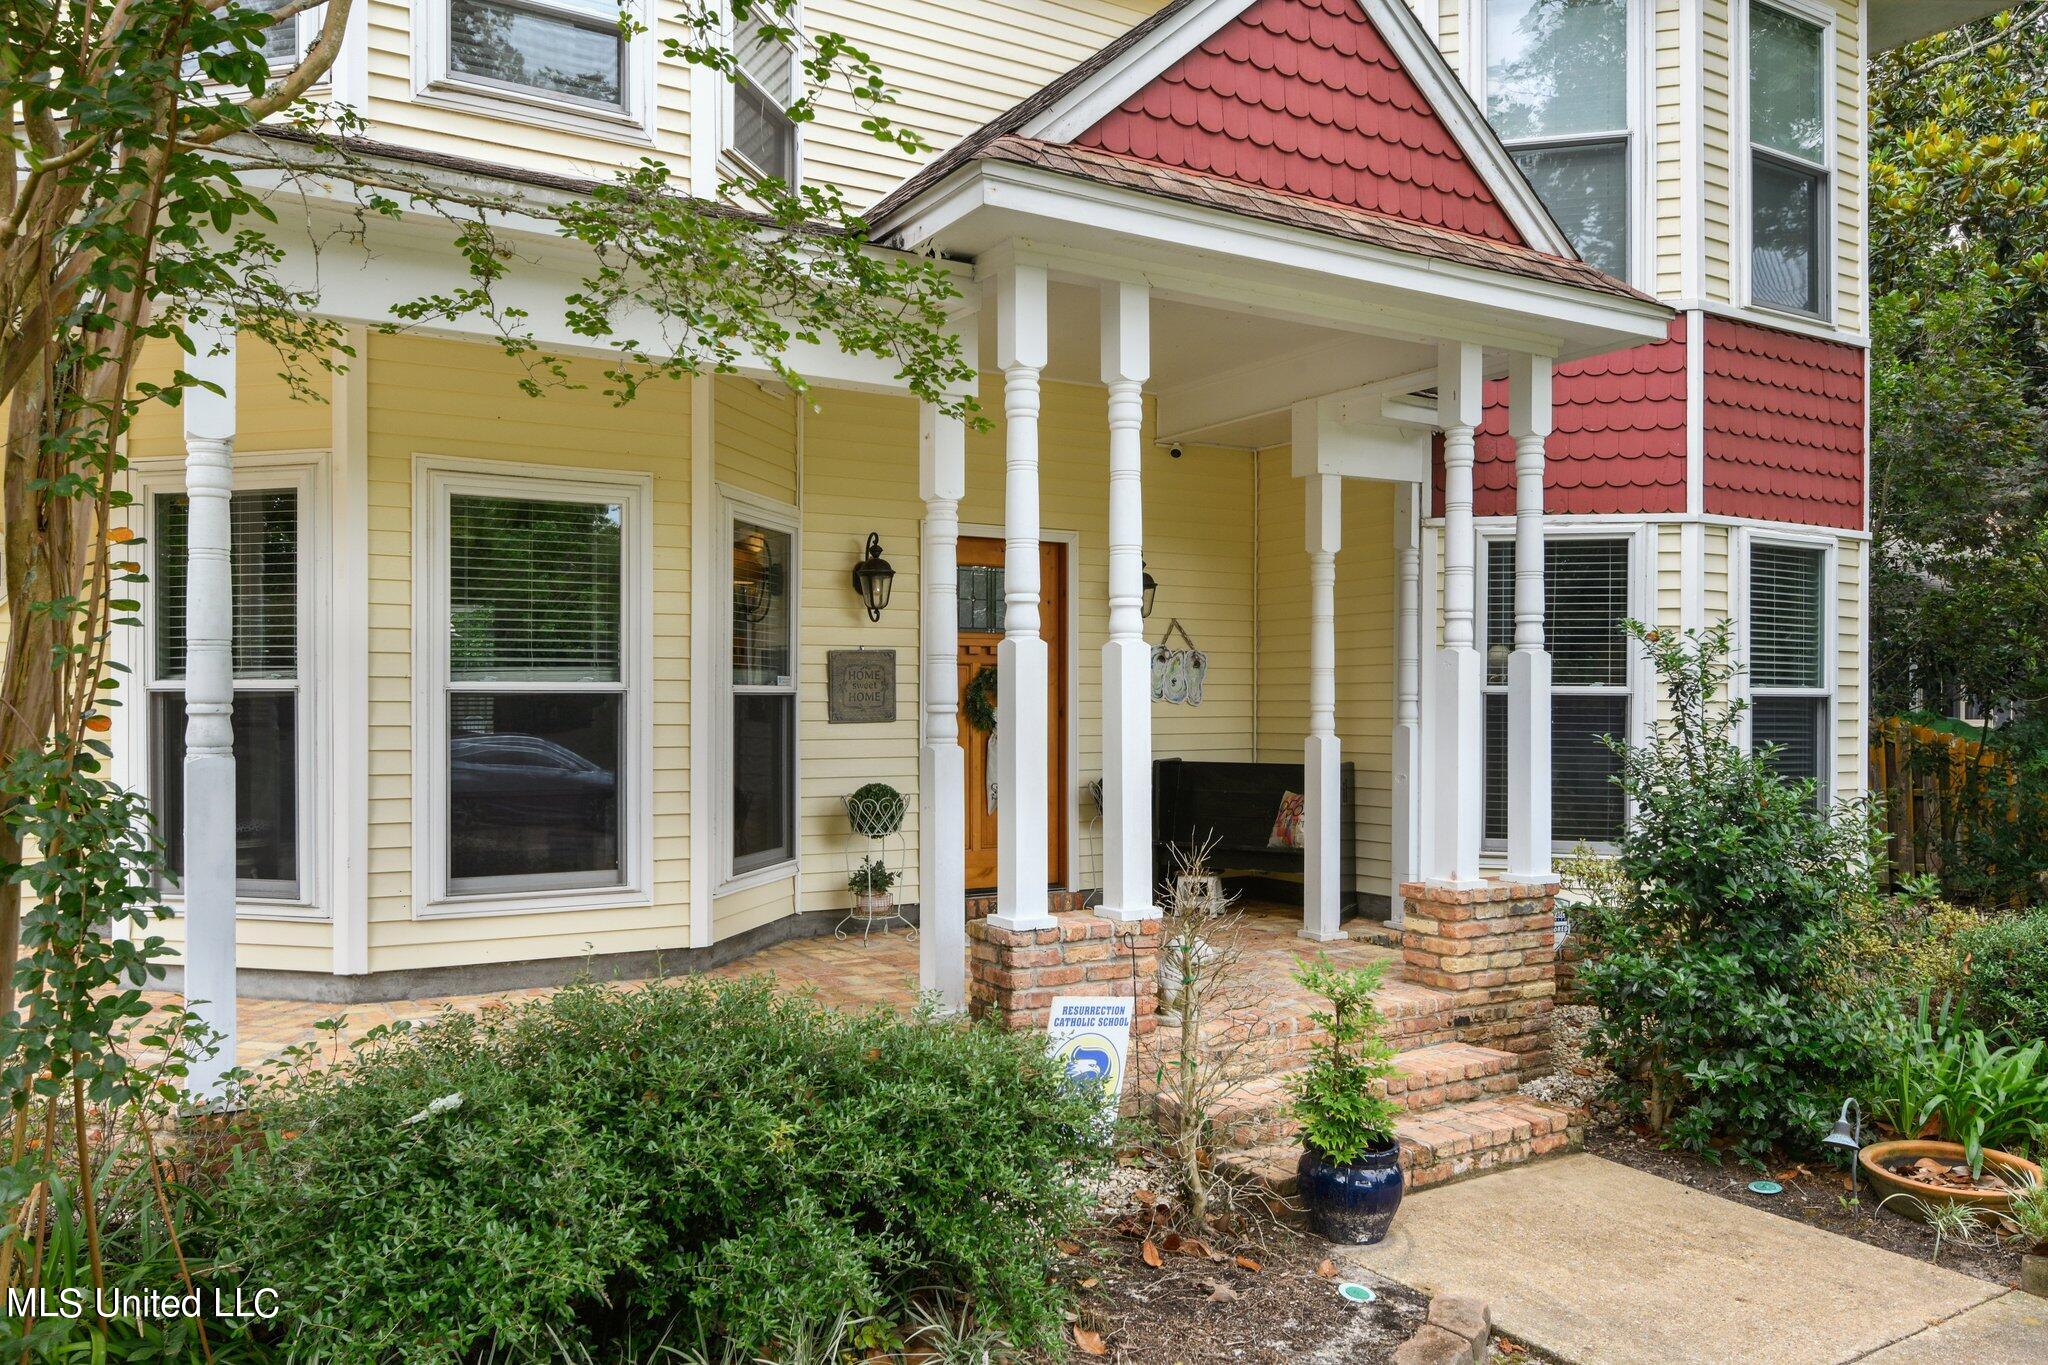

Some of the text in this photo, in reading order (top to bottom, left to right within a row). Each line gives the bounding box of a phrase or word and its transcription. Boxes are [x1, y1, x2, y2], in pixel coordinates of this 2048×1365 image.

[848, 670, 881, 681] HOME
[852, 682, 878, 690] sweet
[848, 692, 881, 702] HOME
[1062, 1006, 1126, 1015] RESURRECTION
[1053, 1017, 1129, 1027] CATHOLIC SCHOOL
